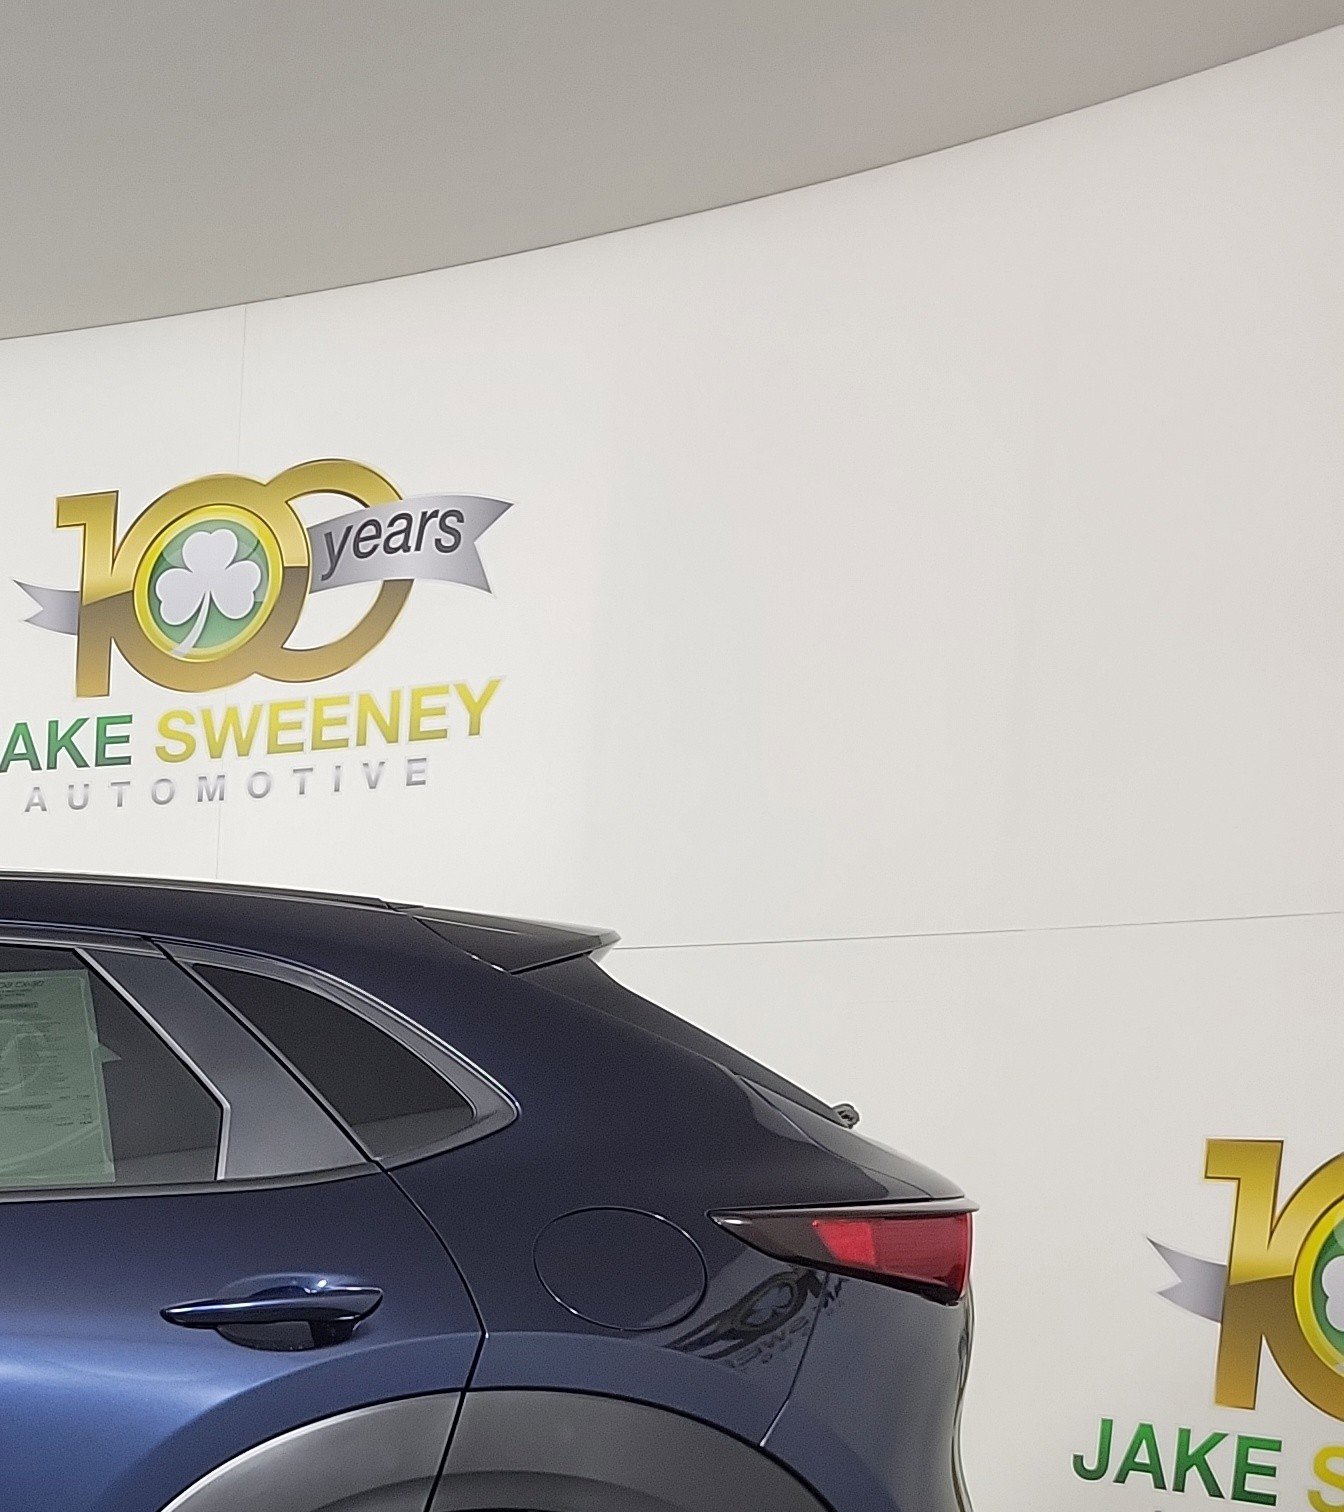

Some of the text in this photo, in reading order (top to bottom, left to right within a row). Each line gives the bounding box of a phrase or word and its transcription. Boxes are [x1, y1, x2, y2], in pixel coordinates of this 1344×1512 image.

[320, 508, 465, 581] years
[155, 678, 502, 763] SWEENEY
[24, 757, 429, 813] AUTOMOTIVE
[1072, 1417, 1283, 1507] JAKE
